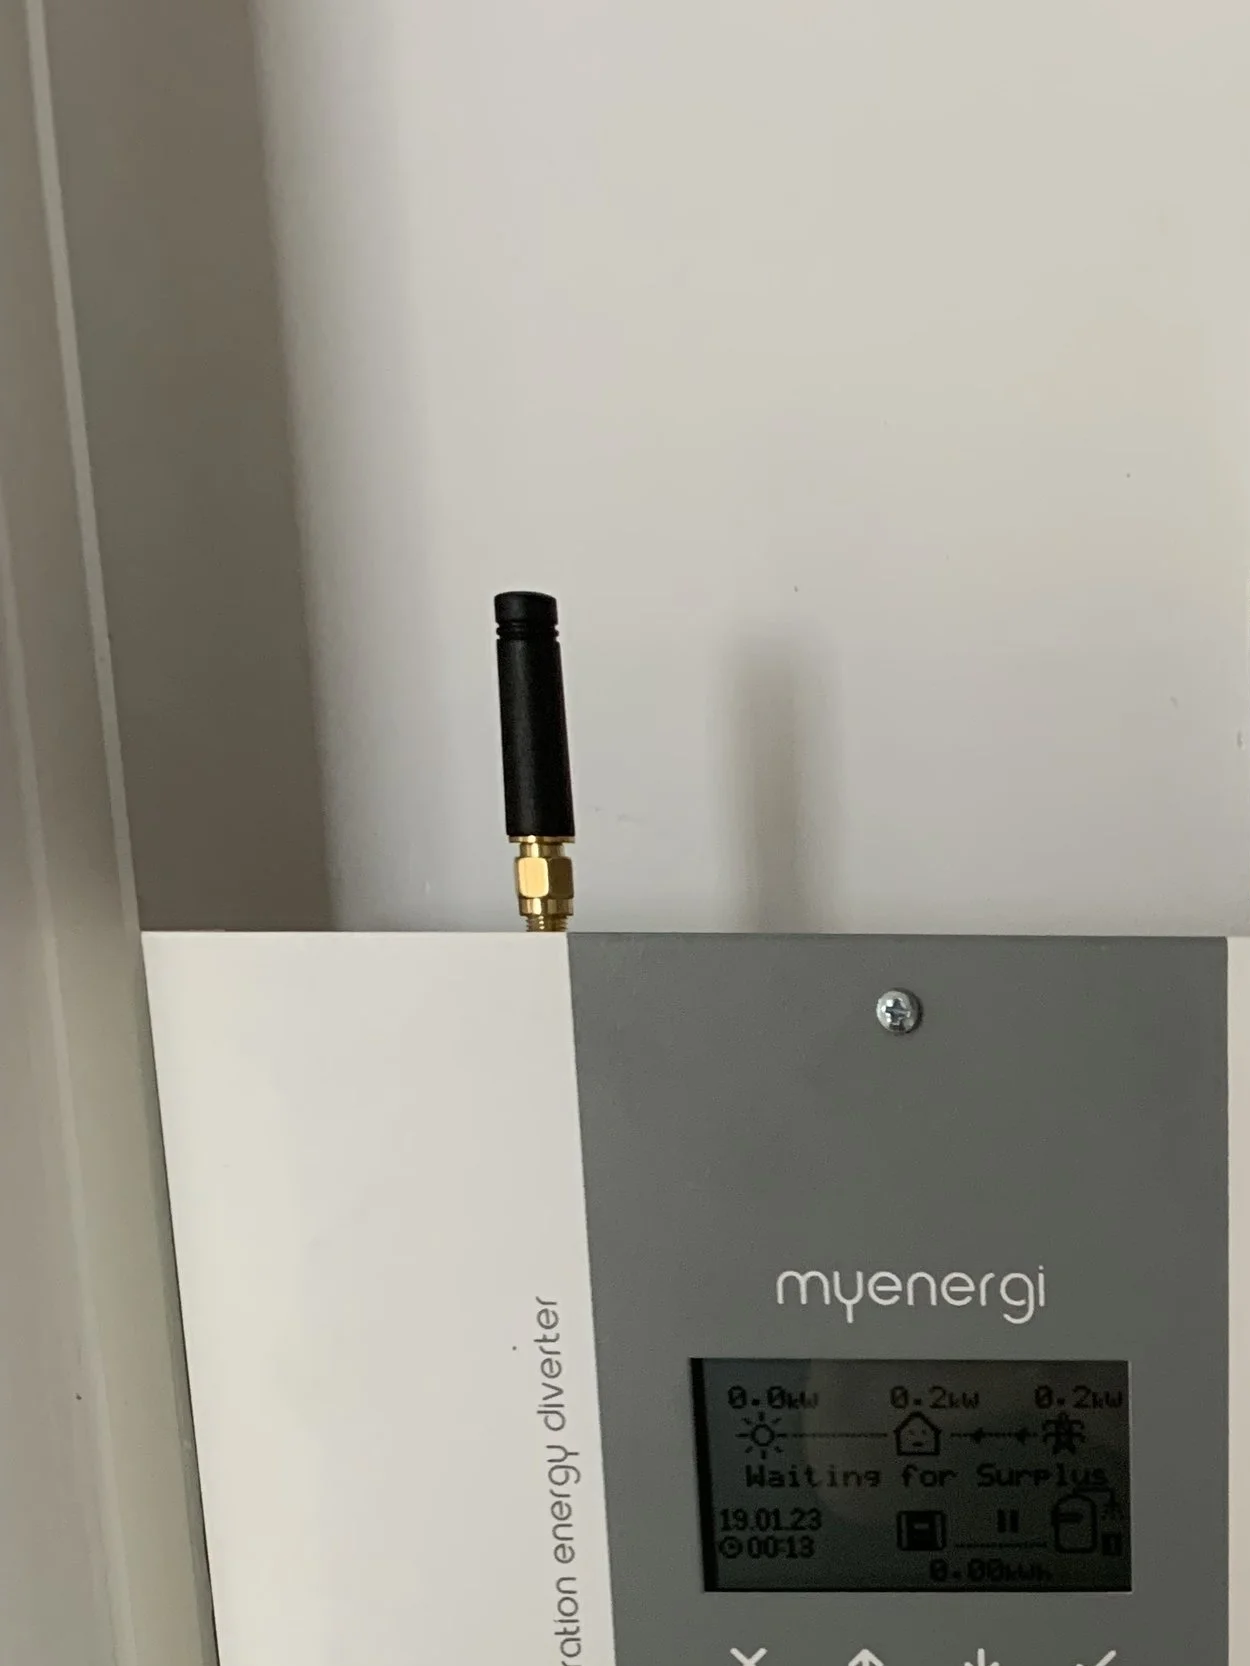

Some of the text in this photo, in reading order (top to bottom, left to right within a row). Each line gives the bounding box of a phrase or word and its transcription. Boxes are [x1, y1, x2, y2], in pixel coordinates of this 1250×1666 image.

[776, 1265, 1045, 1324] myenergi
[532, 1296, 567, 1432] diverter
[745, 1464, 1110, 1487] Waiting for Surplus
[543, 1444, 581, 1564] energy
[719, 1508, 822, 1532] 19.01.23
[747, 1536, 815, 1559] 00:13
